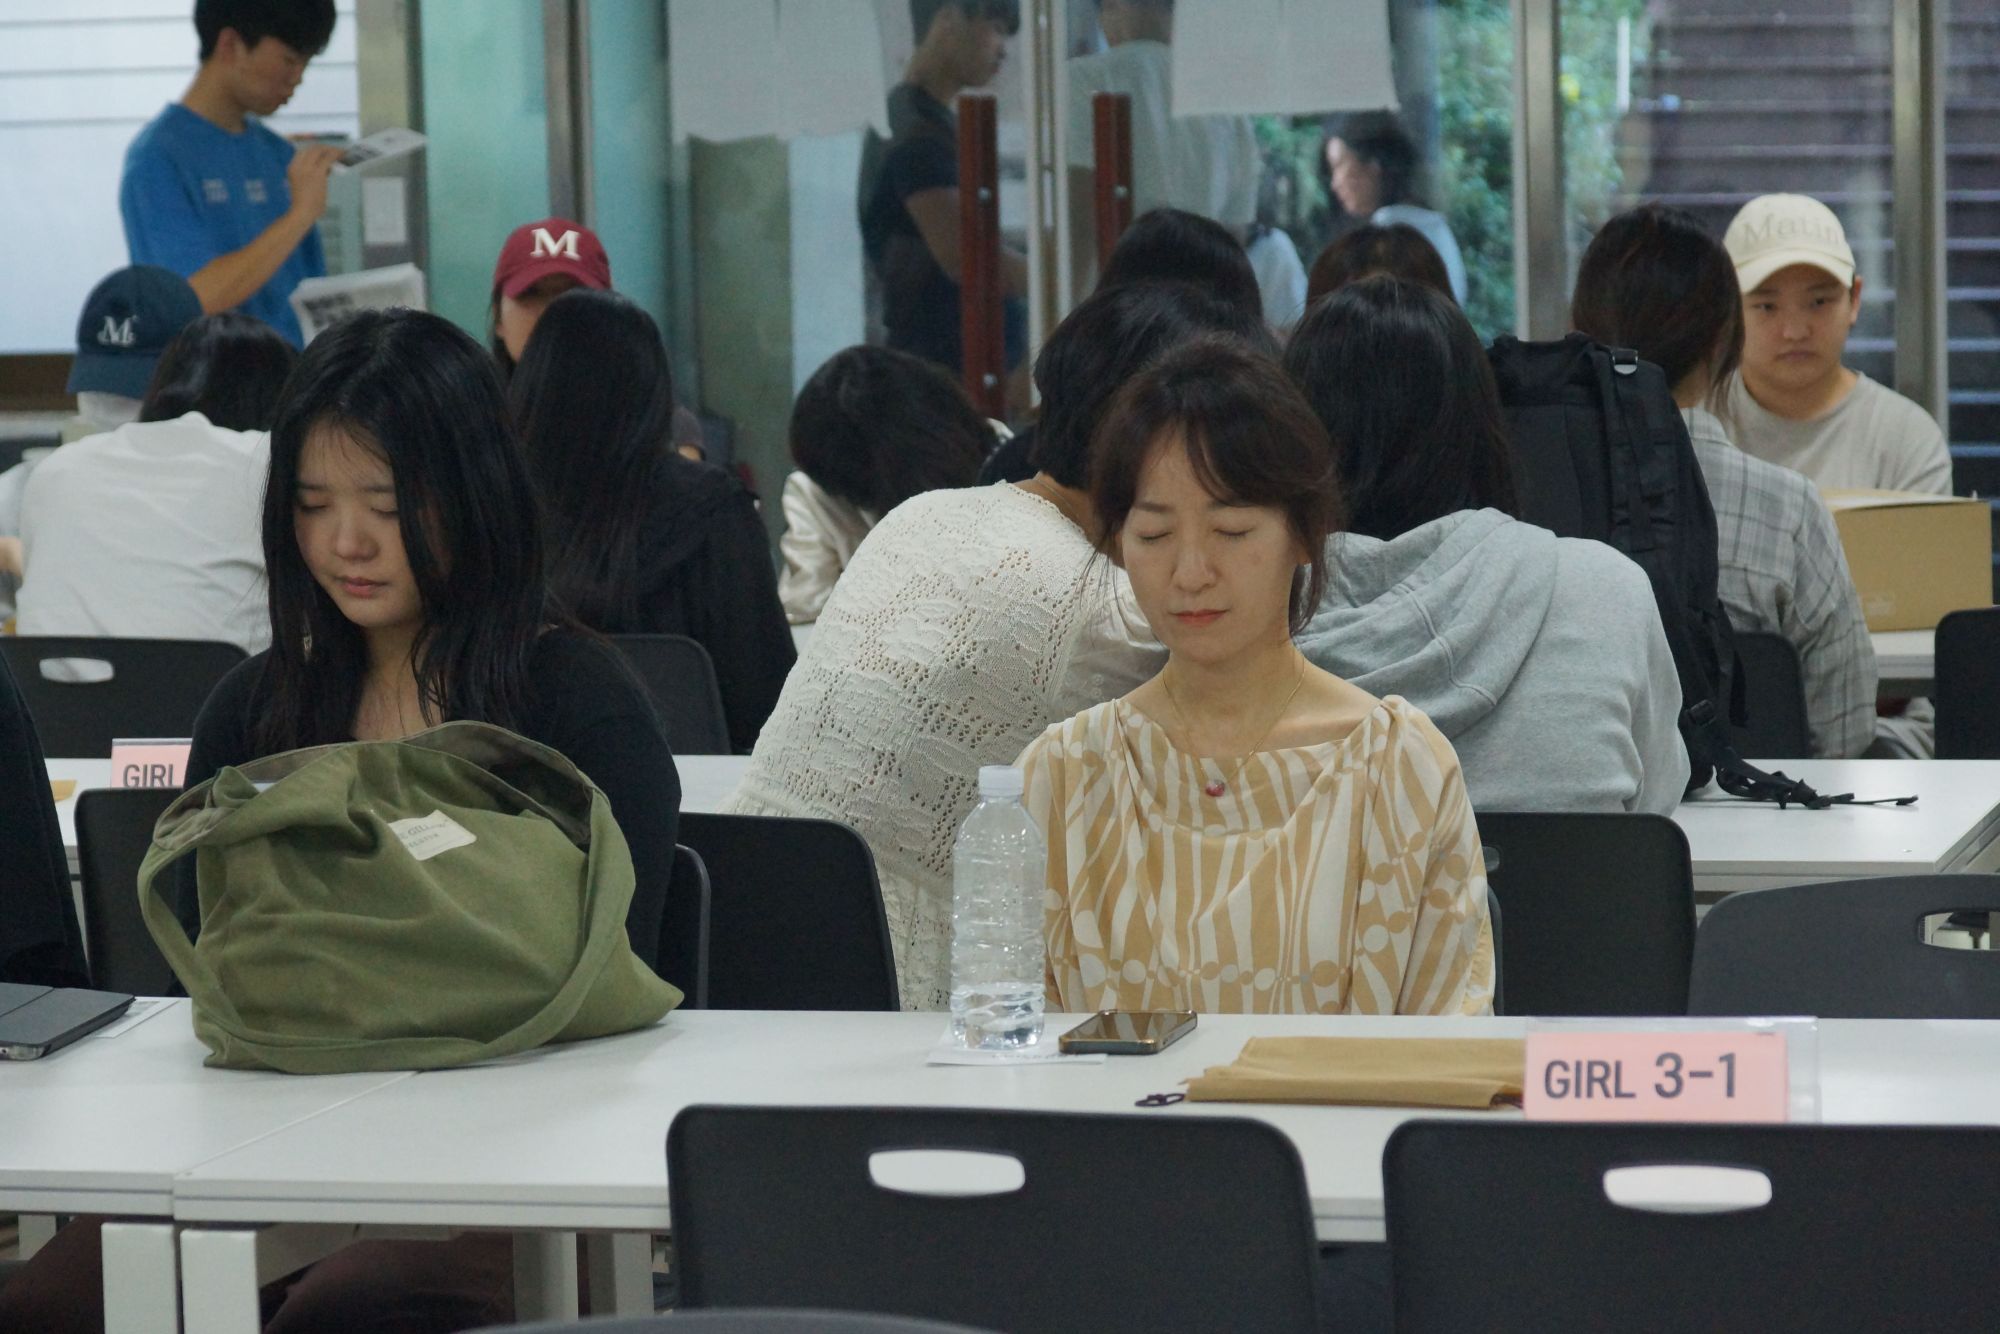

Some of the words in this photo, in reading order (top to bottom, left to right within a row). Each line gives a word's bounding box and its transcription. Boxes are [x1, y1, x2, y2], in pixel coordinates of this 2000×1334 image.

[530, 227, 581, 261] M
[1544, 1059, 1637, 1100] GIRL
[1654, 1051, 1737, 1099] 3-1
